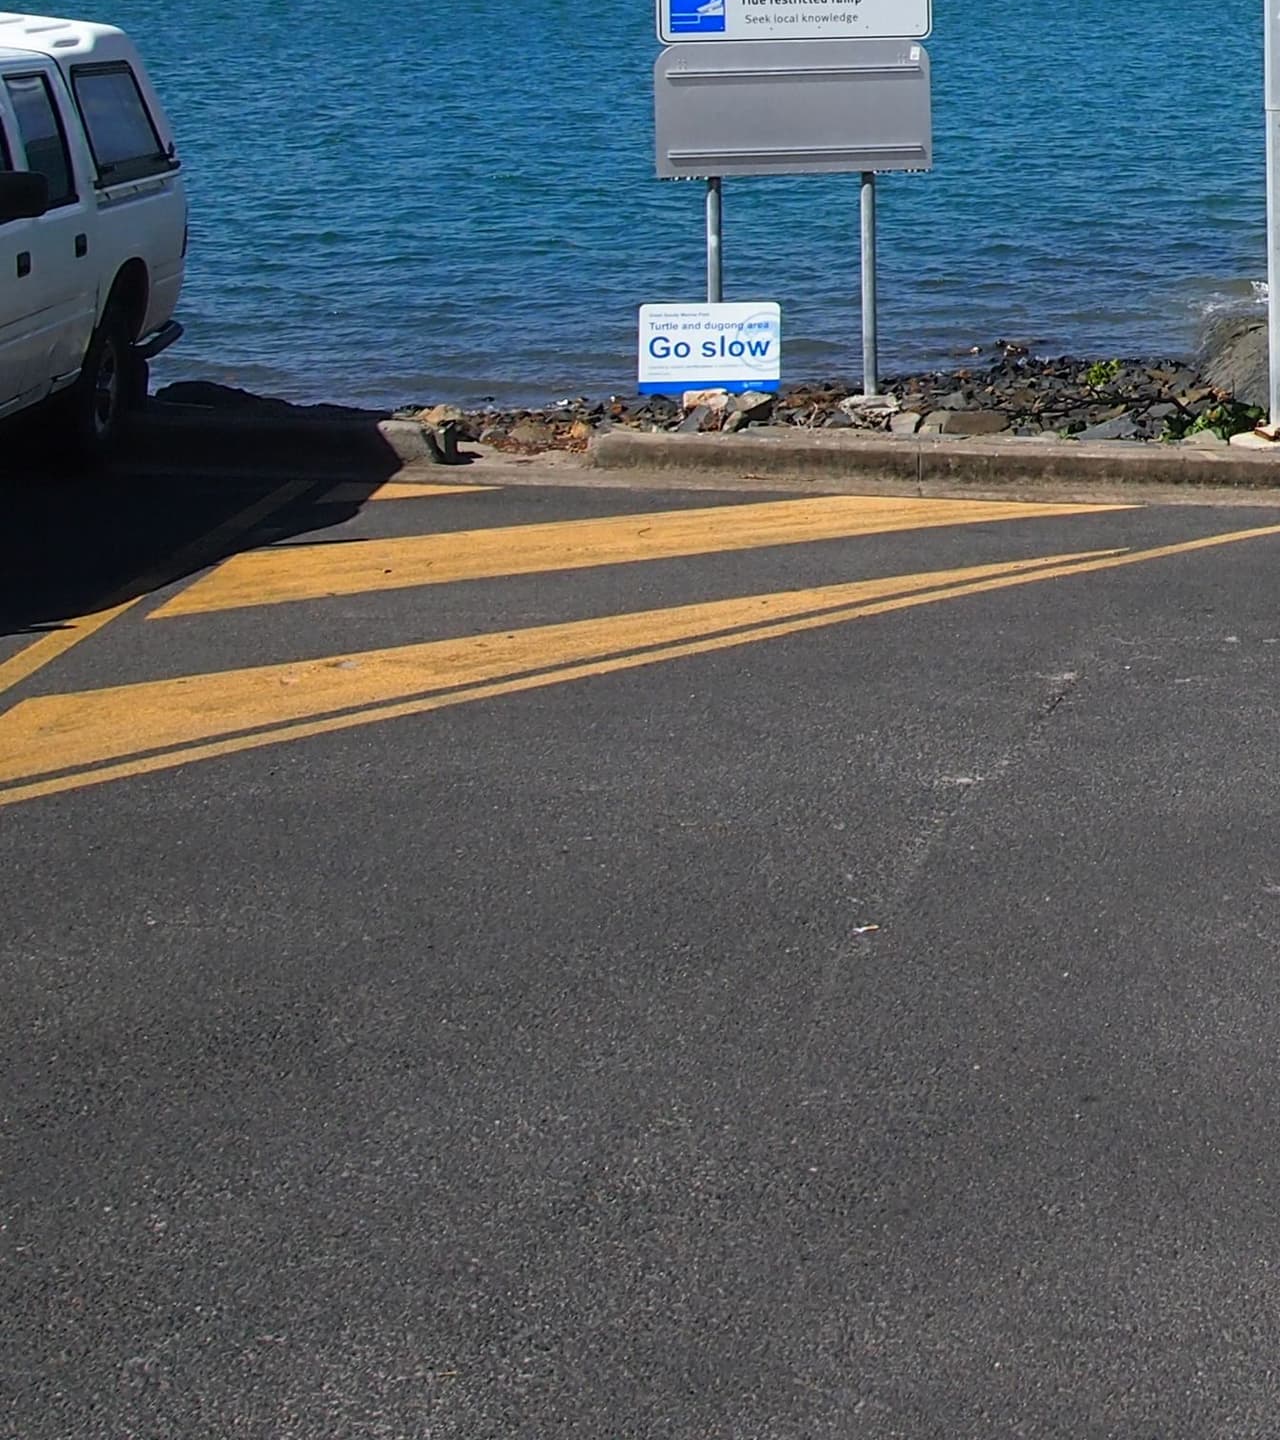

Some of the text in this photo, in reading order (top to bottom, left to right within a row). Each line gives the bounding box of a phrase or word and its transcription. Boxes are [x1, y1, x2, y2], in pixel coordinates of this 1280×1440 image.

[745, 12, 859, 25] Seek local knowledge
[649, 321, 769, 331] Turtle and dugong area
[649, 335, 771, 358] Go slow
